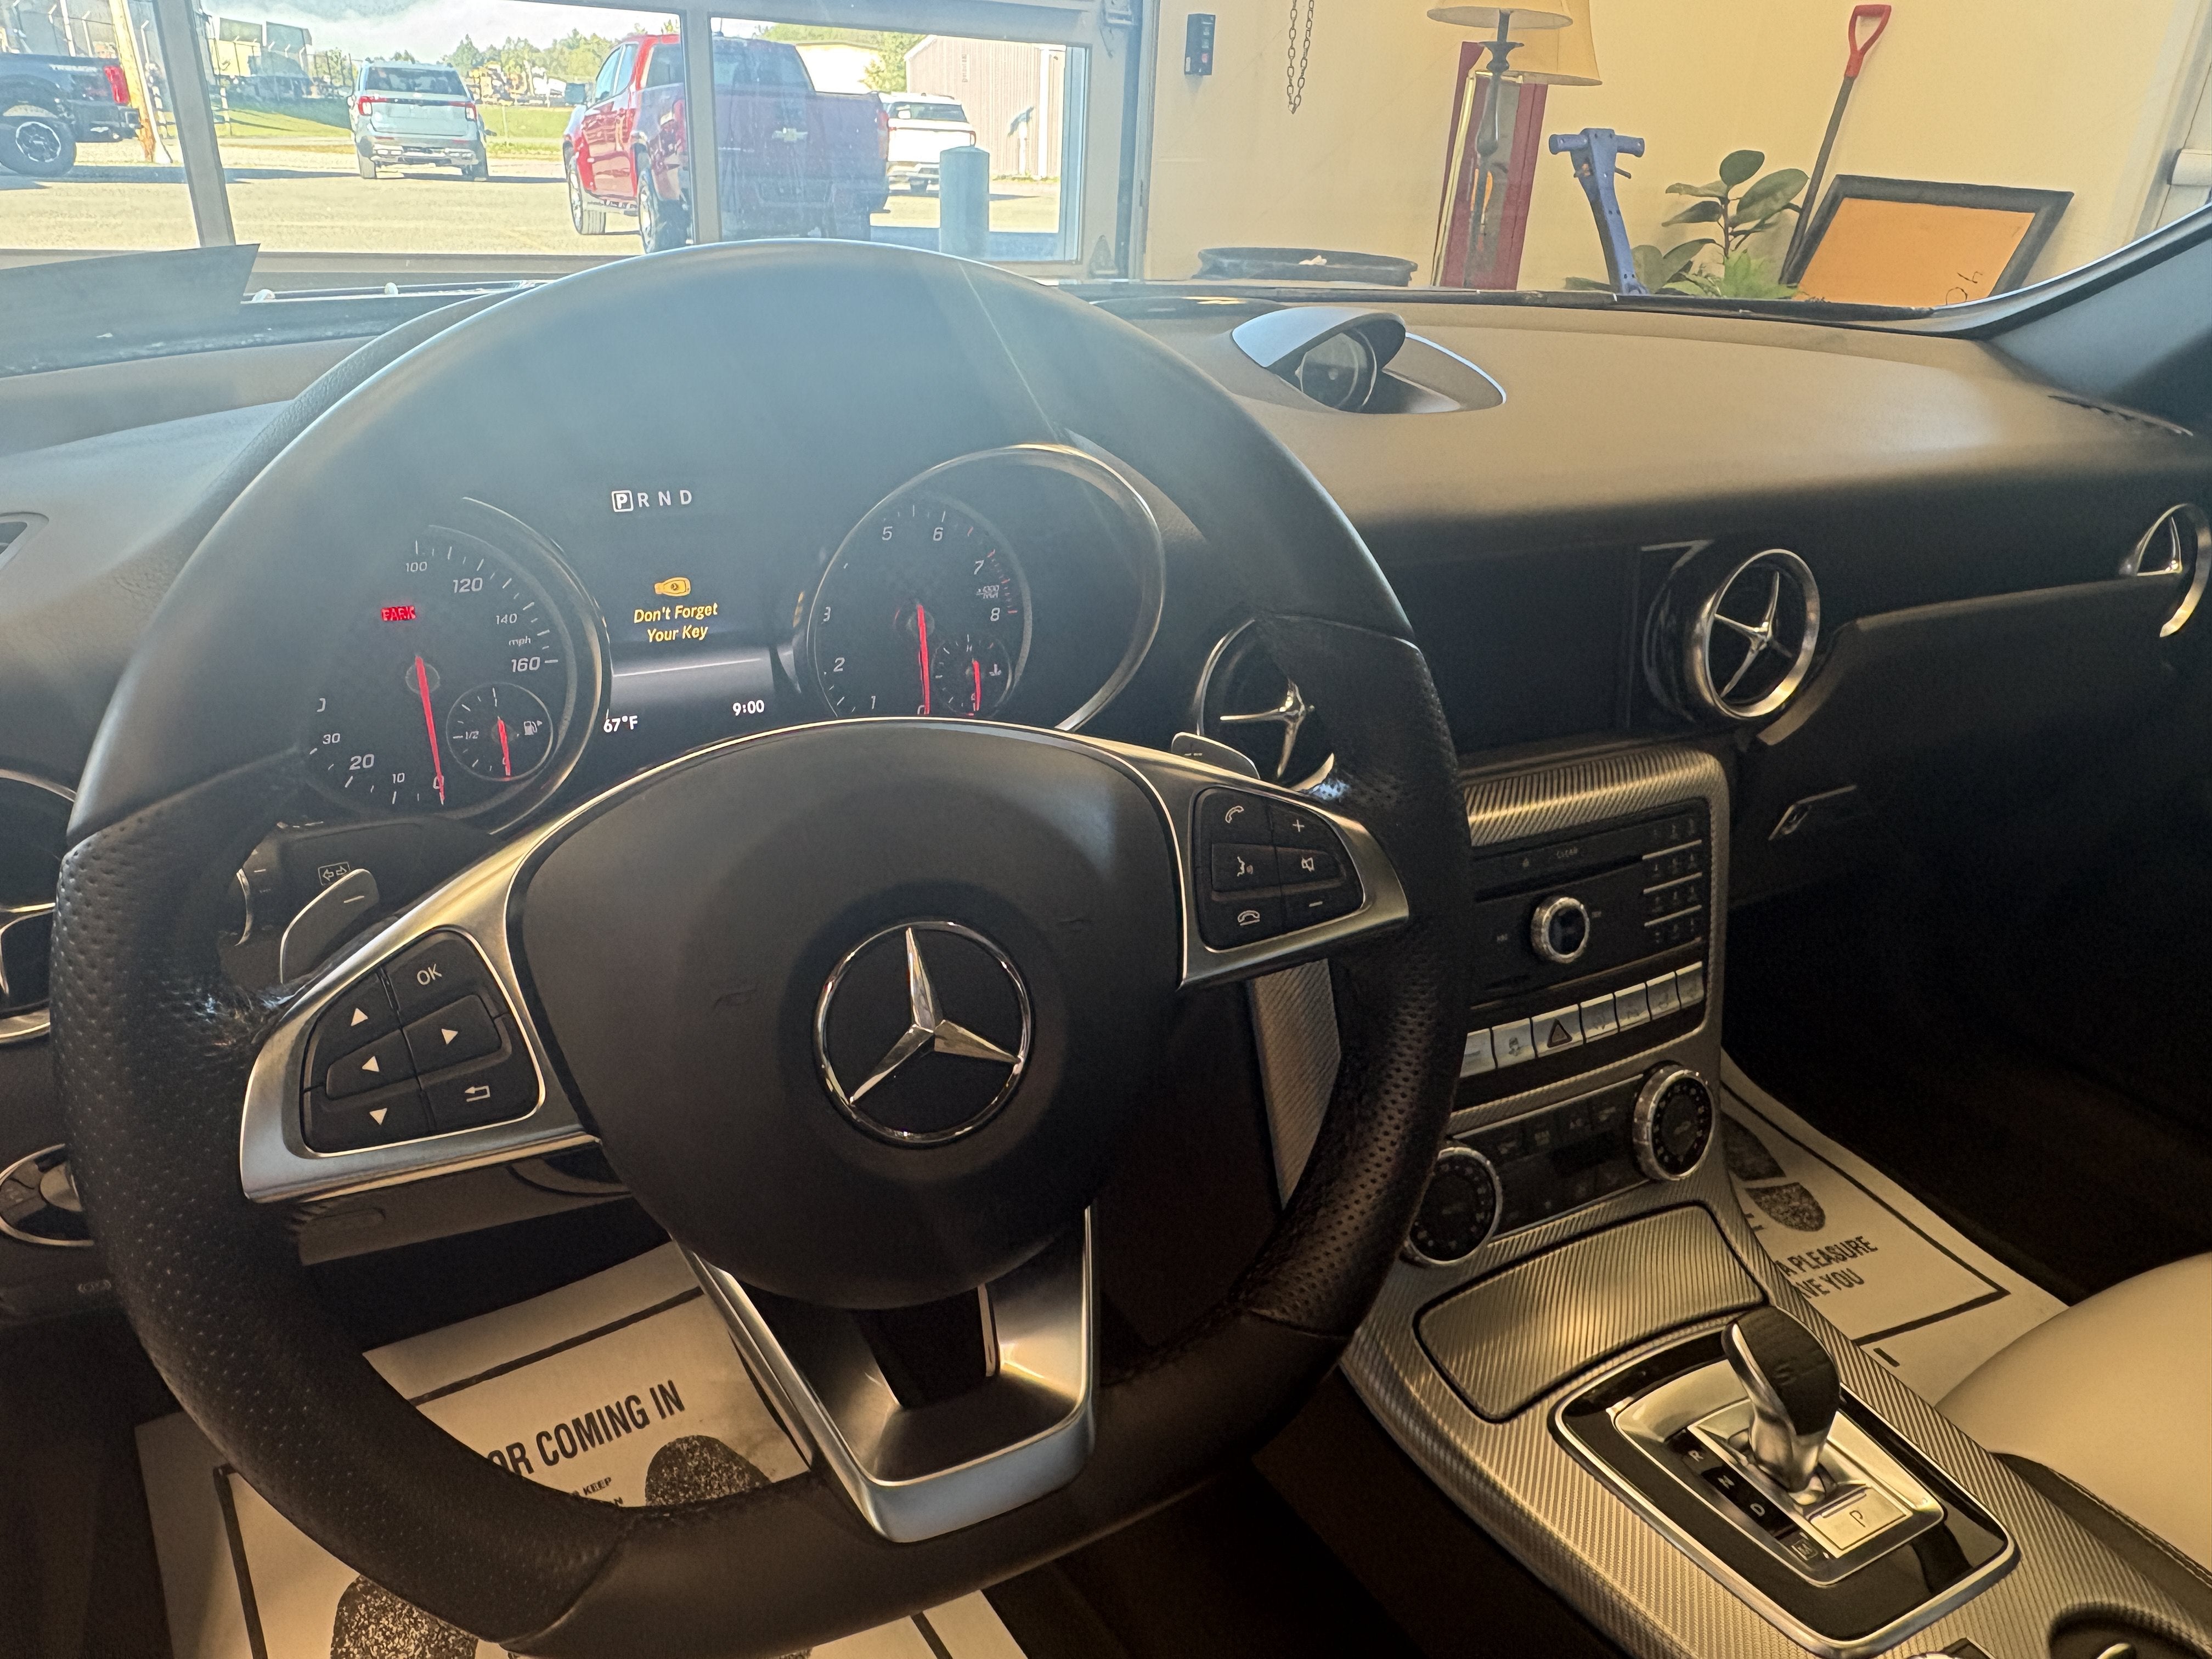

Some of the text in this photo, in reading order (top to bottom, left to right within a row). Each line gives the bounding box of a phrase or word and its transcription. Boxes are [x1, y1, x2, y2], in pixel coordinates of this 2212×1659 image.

[616, 489, 692, 509] P R N D
[882, 527, 893, 540] 5
[933, 527, 944, 541] 6
[405, 561, 427, 572] 100
[973, 560, 984, 575] 7
[453, 577, 483, 593] 120
[496, 613, 517, 624] 140
[634, 602, 718, 623] Don't Forget
[990, 607, 1001, 621] 8
[508, 635, 532, 646] mph
[647, 625, 708, 642] Your Key
[511, 656, 540, 672] 160
[833, 657, 845, 672] 2
[732, 699, 765, 716] 9:00
[871, 696, 876, 709] 1
[603, 715, 638, 733] 67°F
[323, 732, 341, 745] 30
[465, 730, 479, 740] 1/2
[349, 753, 375, 770] 20
[392, 772, 405, 784] 10
[416, 963, 442, 986] OK
[1775, 1235, 1878, 1277] A PLEASURE
[1796, 1268, 1864, 1299] VE YOU
[536, 1395, 650, 1466] COMING
[649, 1379, 685, 1420] IN
[1688, 1449, 1703, 1462] R
[1750, 1503, 1765, 1516] D
[1849, 1510, 1865, 1528] P
